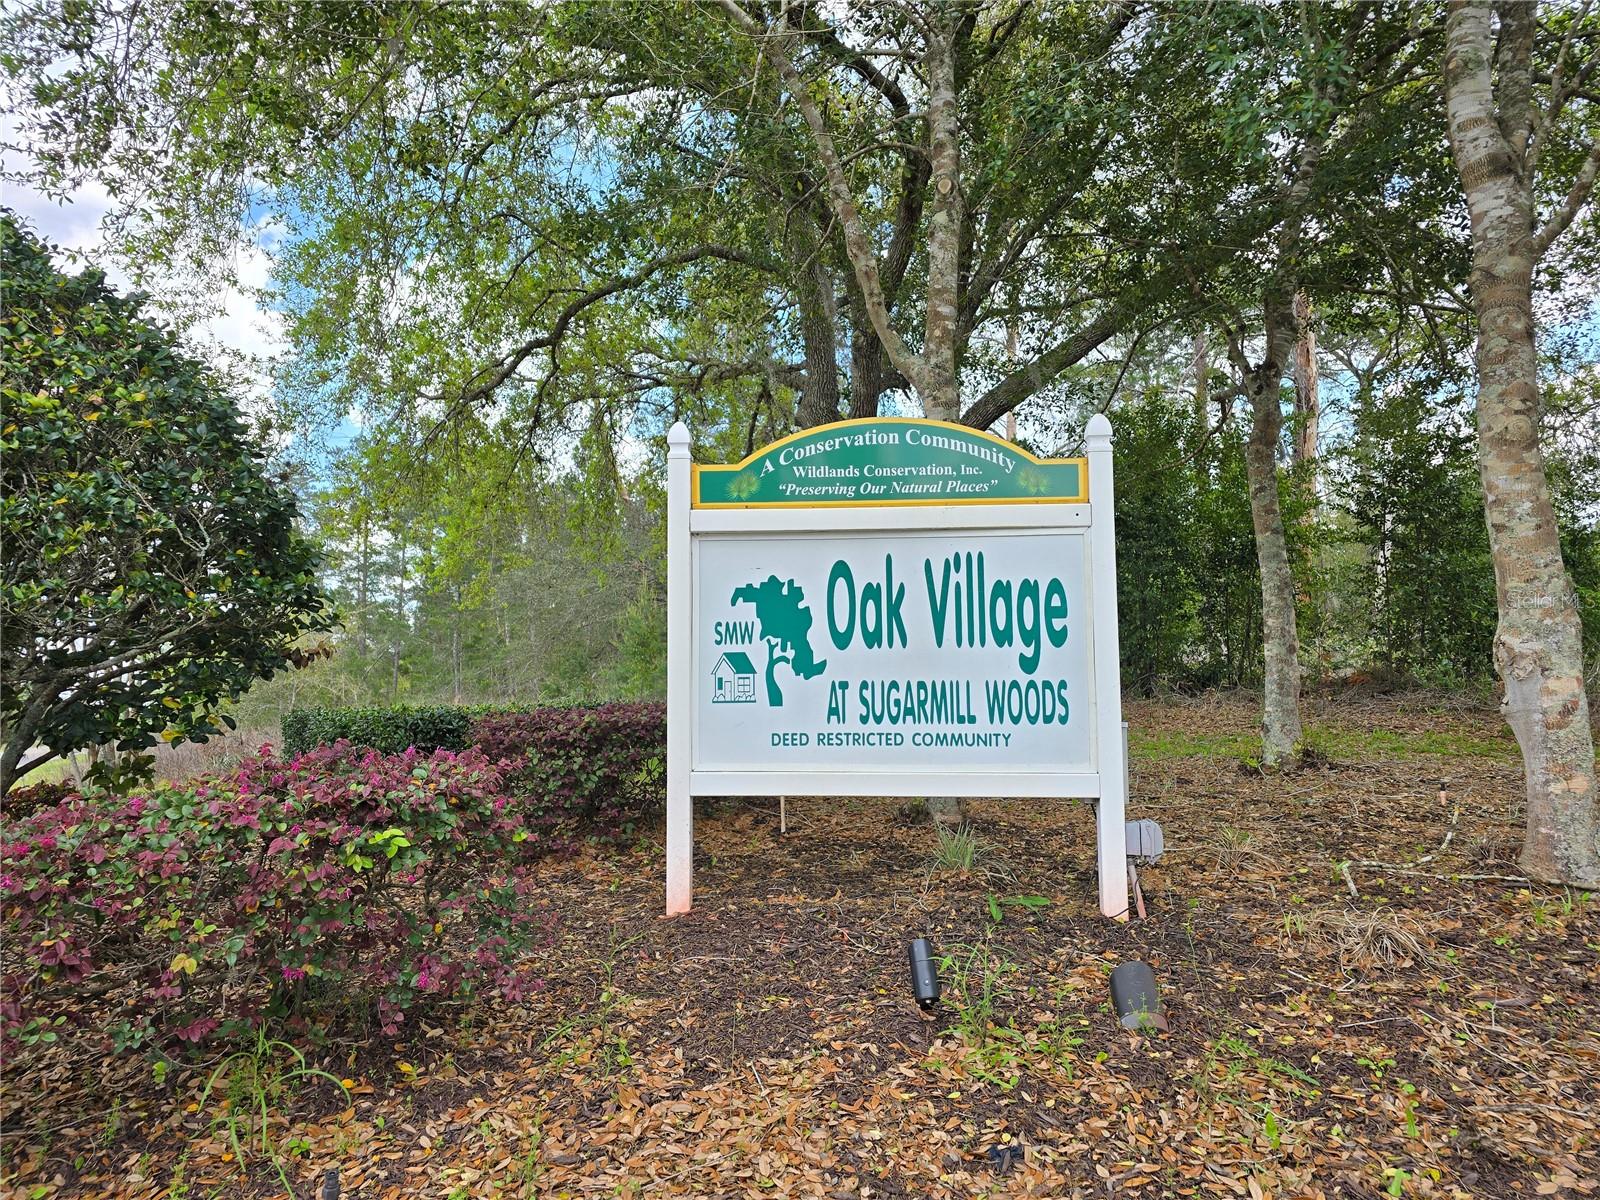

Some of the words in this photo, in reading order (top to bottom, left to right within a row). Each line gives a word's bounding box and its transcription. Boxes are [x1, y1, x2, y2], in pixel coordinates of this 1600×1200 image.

[759, 458, 775, 477] A
[778, 430, 899, 466] Conservation
[905, 429, 1017, 475] Community
[793, 464, 860, 478] Wildlands
[864, 464, 956, 477] Conservation,
[960, 465, 983, 476] Inc.
[860, 482, 886, 494] Our
[889, 480, 942, 494] Natural
[826, 553, 908, 651] Oak
[924, 551, 1068, 675] Village
[714, 621, 754, 645] SMW
[827, 680, 849, 725] AT
[859, 680, 977, 725] SUGARMILL
[985, 679, 1069, 725] WOODS
[771, 732, 810, 747] DEED
[817, 732, 904, 747] RESTRICTED
[911, 732, 1011, 747] COMMUNITY
